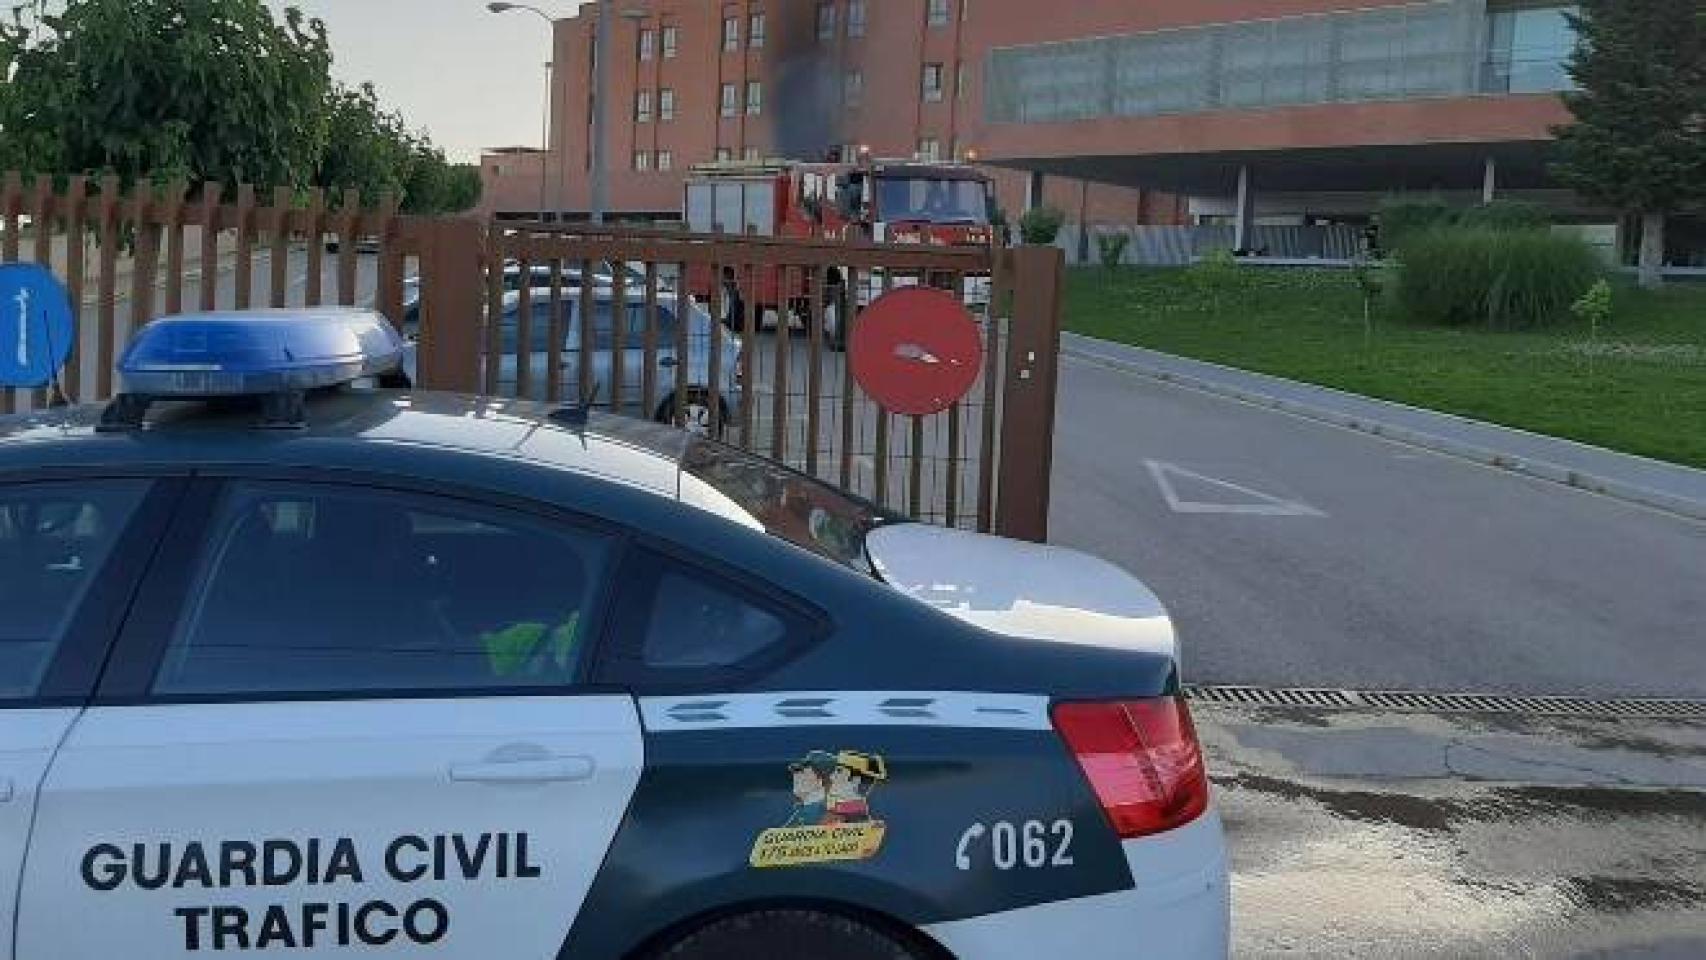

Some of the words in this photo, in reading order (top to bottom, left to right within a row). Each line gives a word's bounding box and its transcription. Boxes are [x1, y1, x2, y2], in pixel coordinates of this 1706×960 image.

[80, 838, 364, 891] GUARDIA
[384, 832, 541, 883] CIVIL
[992, 819, 1074, 870] 062
[174, 898, 450, 951] TRAFICO
